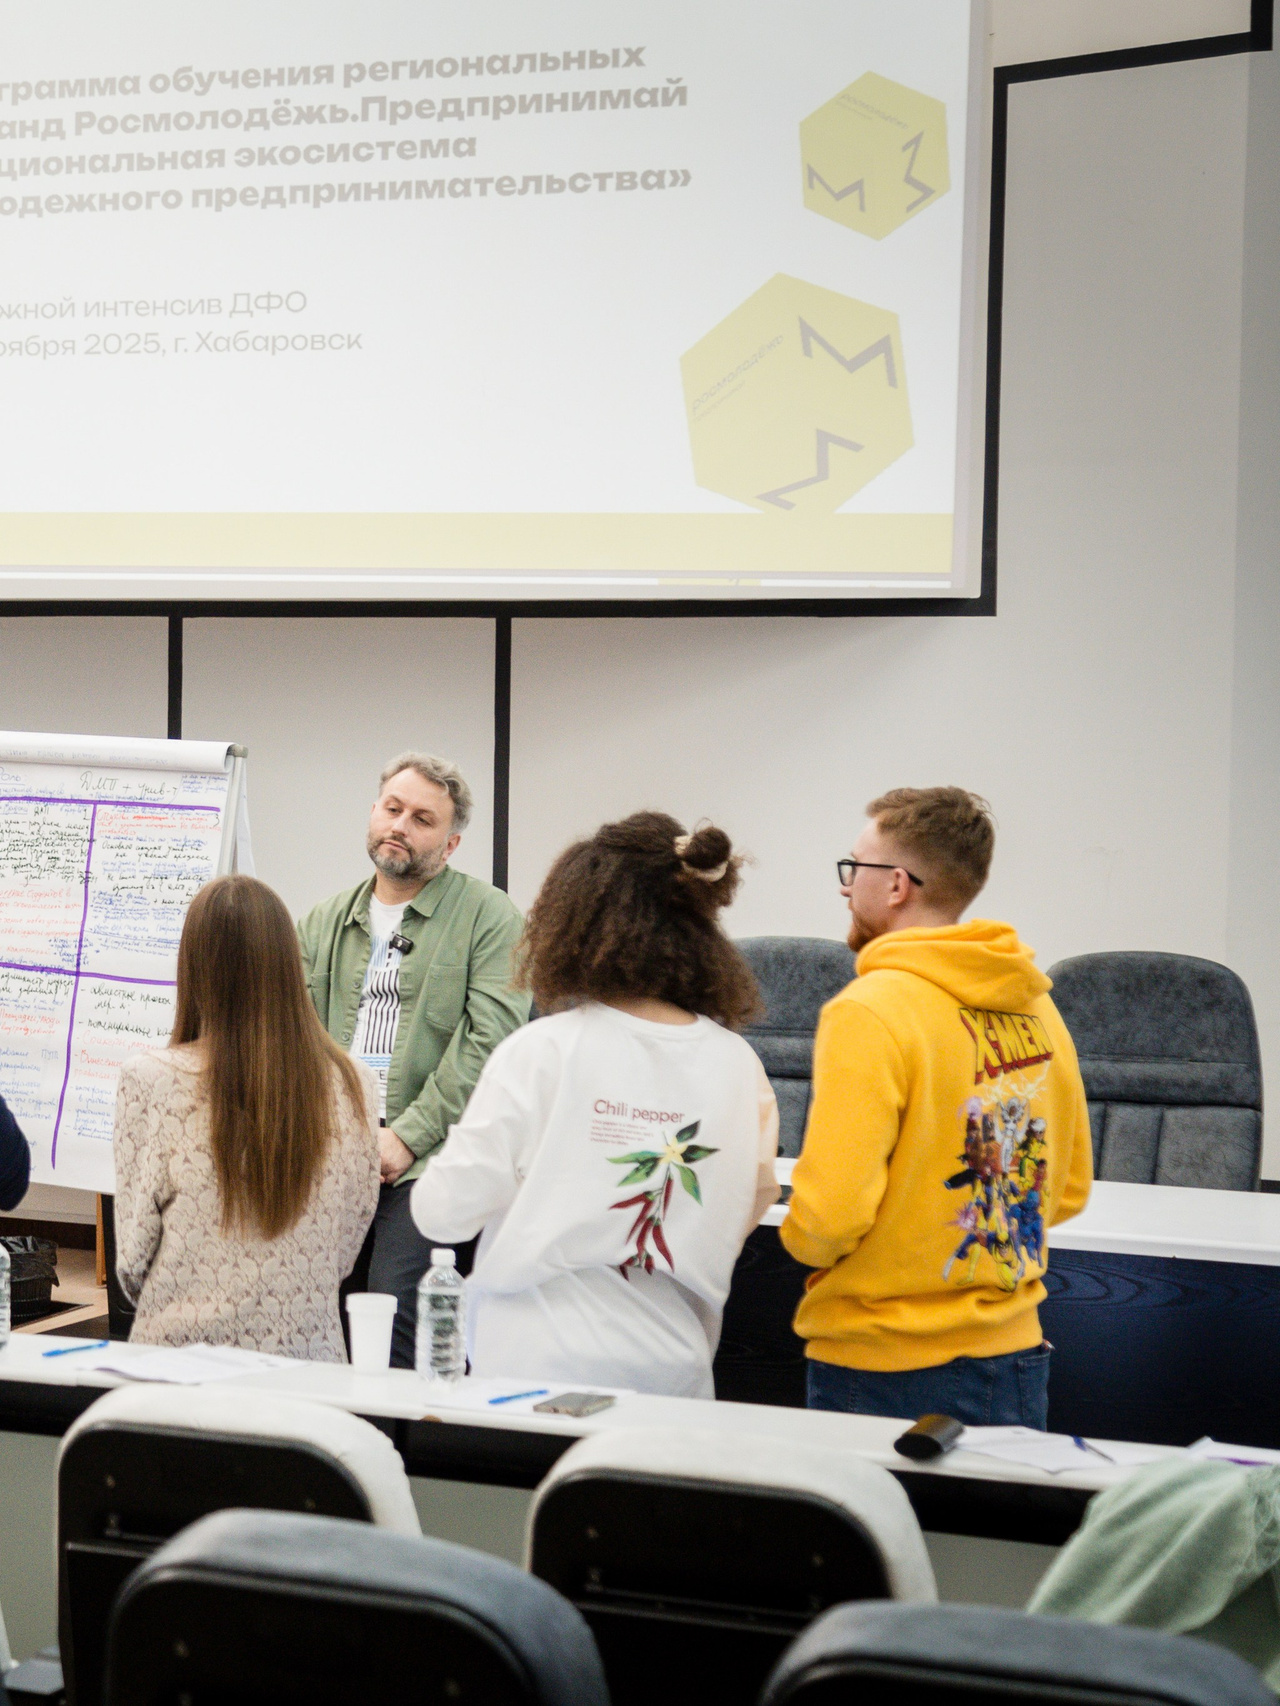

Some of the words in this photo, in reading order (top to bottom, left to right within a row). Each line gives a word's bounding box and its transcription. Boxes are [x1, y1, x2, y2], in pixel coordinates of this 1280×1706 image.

[149, 64, 335, 96] обучения
[343, 46, 646, 89] региональных
[75, 77, 688, 136] Росмолодёжь.Предпринимай
[234, 136, 477, 168] экосистема
[192, 168, 692, 212] предпринимательства»
[84, 298, 223, 318] интенсив
[228, 290, 308, 318] ДФО
[84, 332, 166, 357] 2025,
[174, 337, 189, 354] г.
[195, 329, 363, 356] Хабаровск
[593, 1098, 629, 1118] Chili
[631, 1107, 686, 1126] pepper
